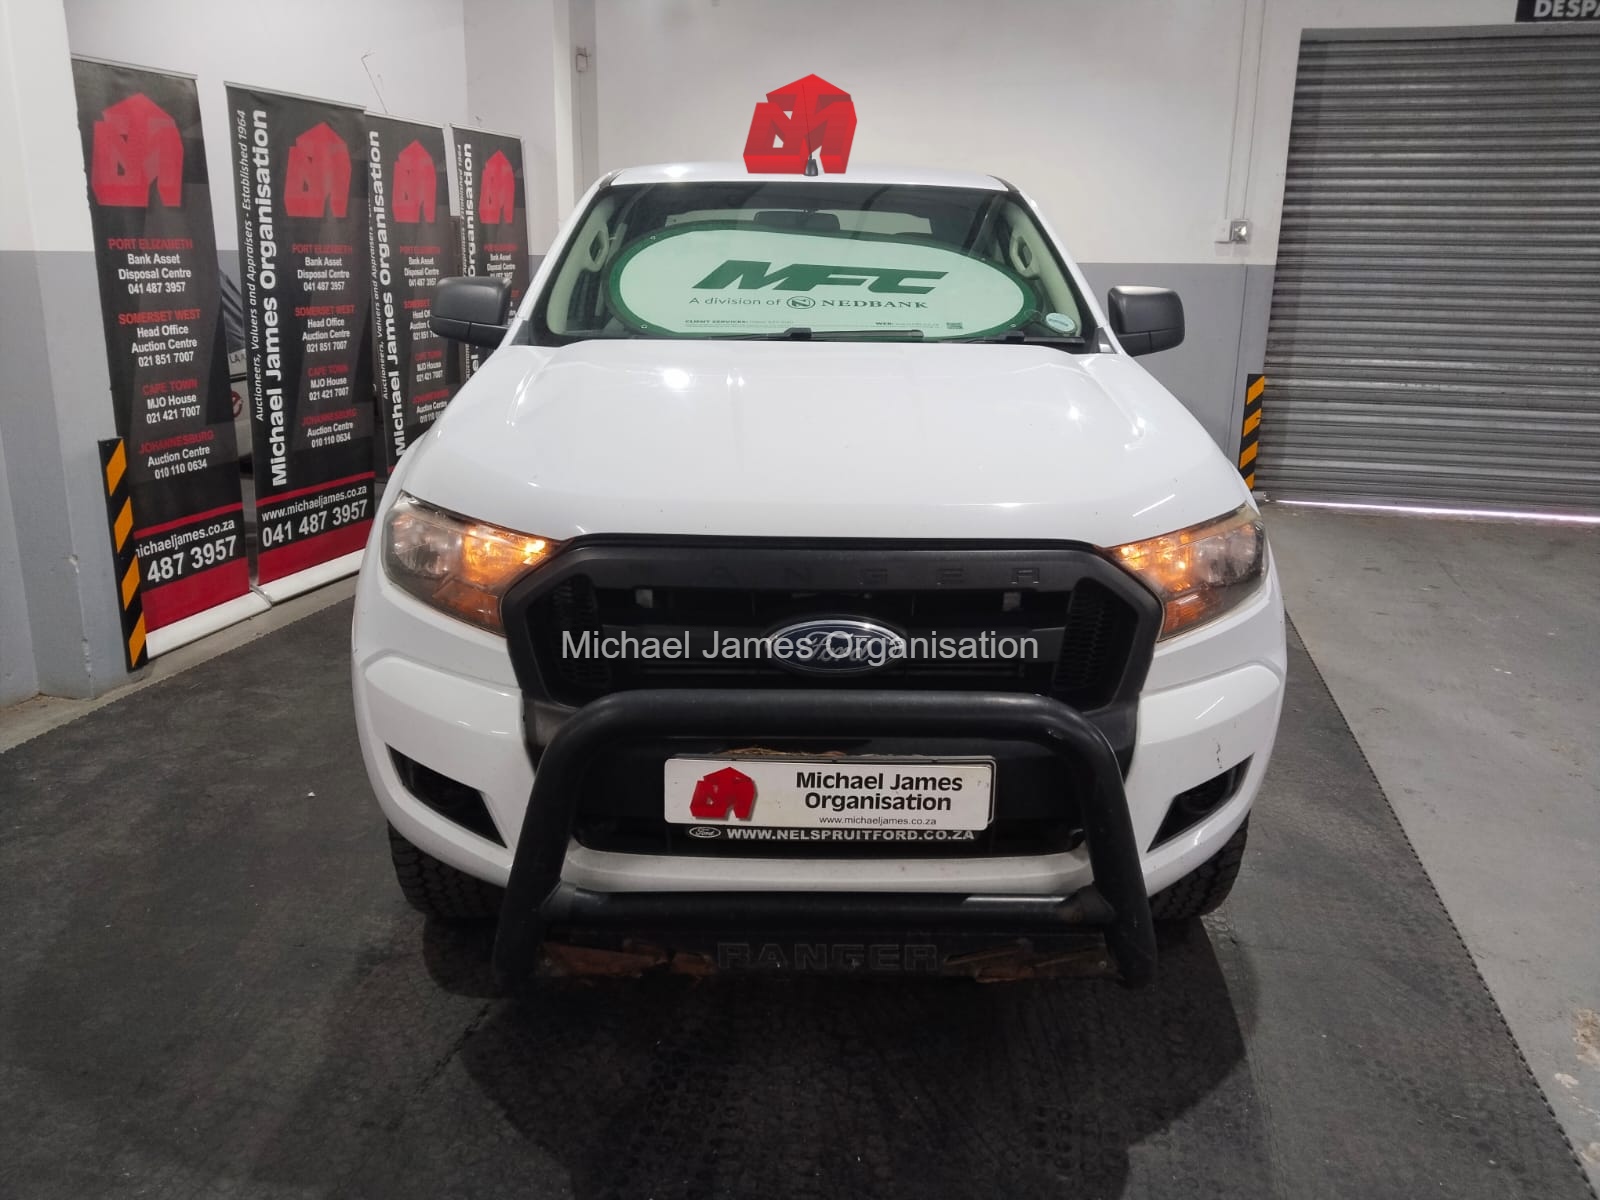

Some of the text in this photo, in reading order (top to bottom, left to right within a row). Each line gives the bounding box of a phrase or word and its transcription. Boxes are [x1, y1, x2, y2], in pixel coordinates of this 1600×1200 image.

[236, 109, 246, 141] 1964
[239, 142, 251, 210] Established
[464, 144, 476, 277] Organisation
[108, 238, 136, 250] PORT
[245, 220, 257, 282] Appraisers
[127, 253, 180, 265] Bank Asset
[305, 257, 342, 266] Bank Asset
[118, 267, 191, 281] Disposal Centre
[297, 269, 350, 280] Disposal Centre
[691, 259, 949, 295] MFC
[128, 282, 186, 294] 041 487 3957
[249, 284, 257, 306] and
[303, 282, 315, 292] 041
[369, 131, 406, 456] Michael James Organisation
[252, 110, 288, 487] Michael James Organisation
[704, 297, 762, 306] division
[766, 297, 781, 305] of
[821, 300, 928, 309] NEDBANK
[118, 308, 200, 325] SOMERSET WEST
[307, 317, 345, 329] Head Office
[375, 303, 383, 338] Valuers
[137, 325, 189, 338] Head Office
[250, 309, 260, 350] Valuers
[302, 328, 350, 341] Auction Centre
[131, 338, 197, 354] Auction Centre
[306, 343, 318, 353] 021
[319, 342, 331, 352] 851
[138, 351, 194, 367] 021 851 7007
[253, 353, 264, 421] Auctioneers,
[310, 376, 347, 389] MJO House
[147, 394, 197, 409] MJO House
[309, 391, 320, 401] 021
[321, 389, 333, 399] 421
[146, 405, 200, 424] 021 421 7007
[307, 422, 353, 437] Auction Centre
[311, 432, 350, 448] 010 110 0634
[148, 446, 210, 467] Auction Centre
[154, 458, 207, 480] 010 110 0634
[261, 485, 367, 522] www.michaeljames.co.za
[262, 499, 368, 548] 041 487 3957
[147, 534, 237, 583] 487 3957
[796, 771, 963, 792] Michael James
[805, 792, 952, 812] Organisation
[819, 815, 937, 827] www.michaeljames.co.za
[727, 828, 975, 841] WWW.NELSPRUITFORD.CO.ZA
[717, 943, 940, 970] RANGER
